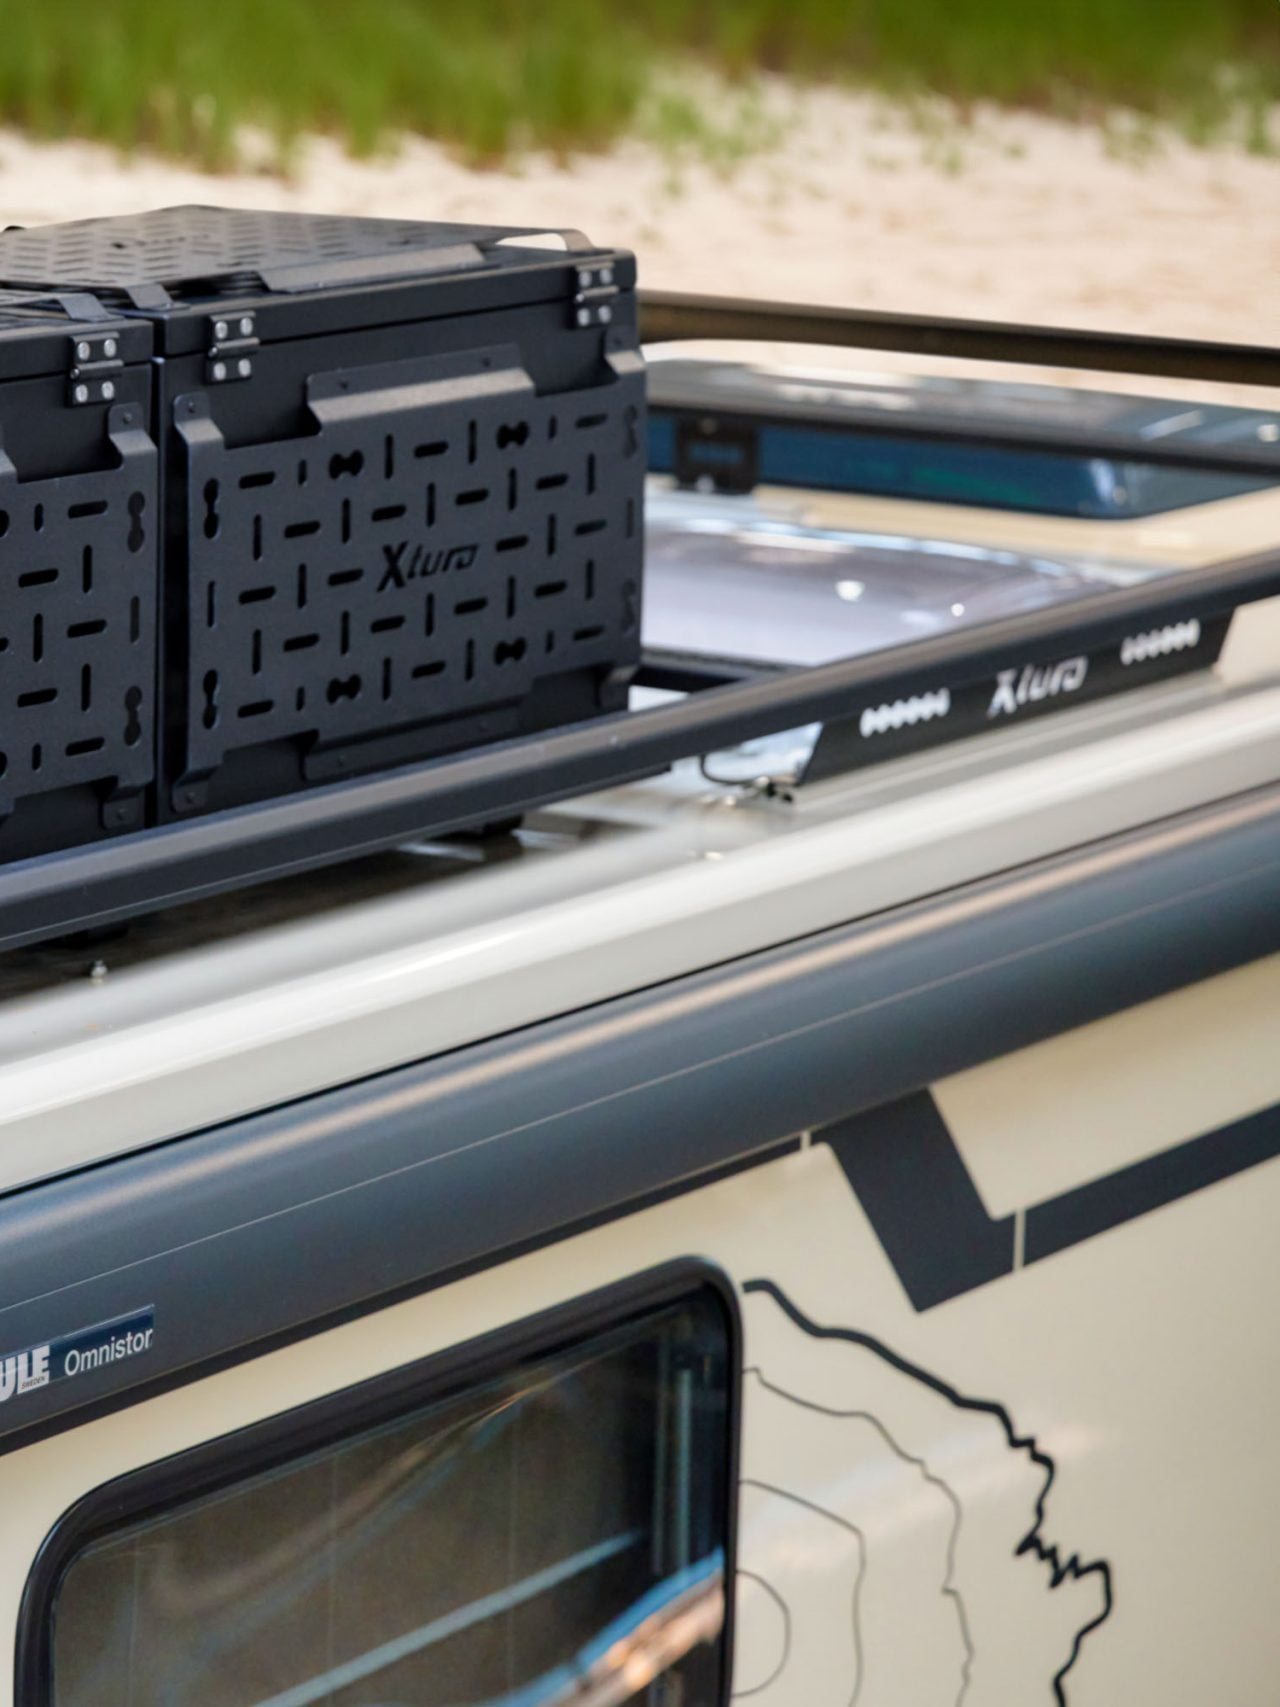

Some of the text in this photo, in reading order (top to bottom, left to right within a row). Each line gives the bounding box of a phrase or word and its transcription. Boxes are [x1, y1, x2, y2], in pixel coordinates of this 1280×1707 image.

[376, 541, 479, 592] Xtura
[986, 656, 1089, 720] Xtura
[64, 1328, 154, 1376] Omnistor
